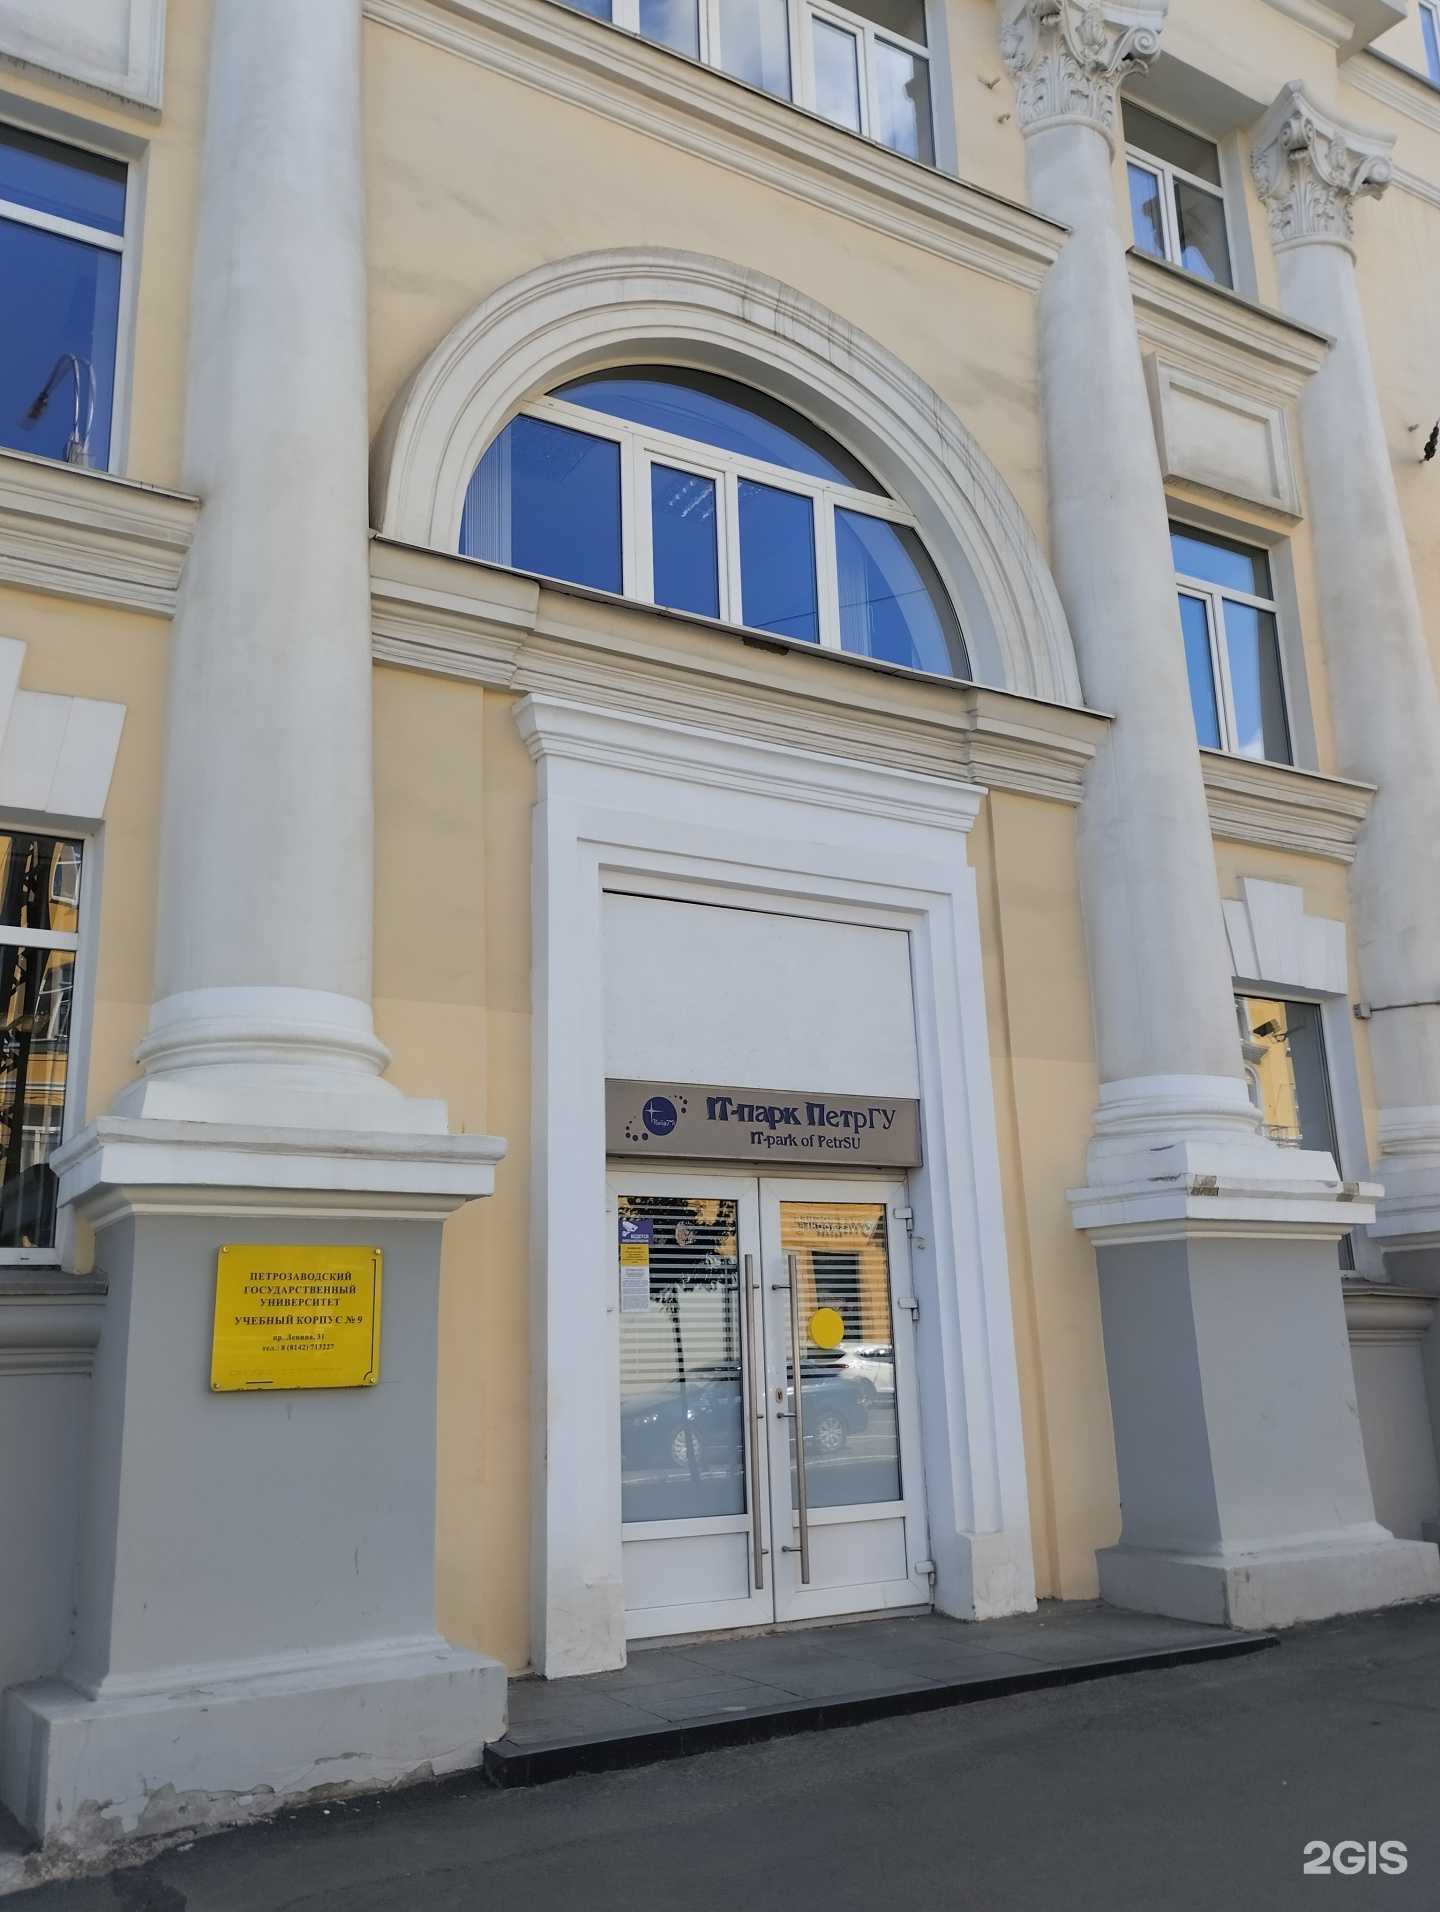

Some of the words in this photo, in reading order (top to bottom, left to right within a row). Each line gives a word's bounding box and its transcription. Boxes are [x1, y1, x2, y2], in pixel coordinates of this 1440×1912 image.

[805, 1101, 896, 1134] ПетрГУ
[750, 1131, 797, 1148] IT-park
[801, 1134, 814, 1148] of
[818, 1135, 861, 1150] PetrSU
[250, 1272, 352, 1281] ПЕТРОЗАВОДСКИЙ
[243, 1285, 356, 1295] ГОСУДАРСТВЕННЫЙ
[260, 1298, 340, 1307] УНИВЕРСИТЕТ
[234, 1316, 293, 1325] УЧЕБНЫЙ
[297, 1316, 343, 1325] КОРПУС
